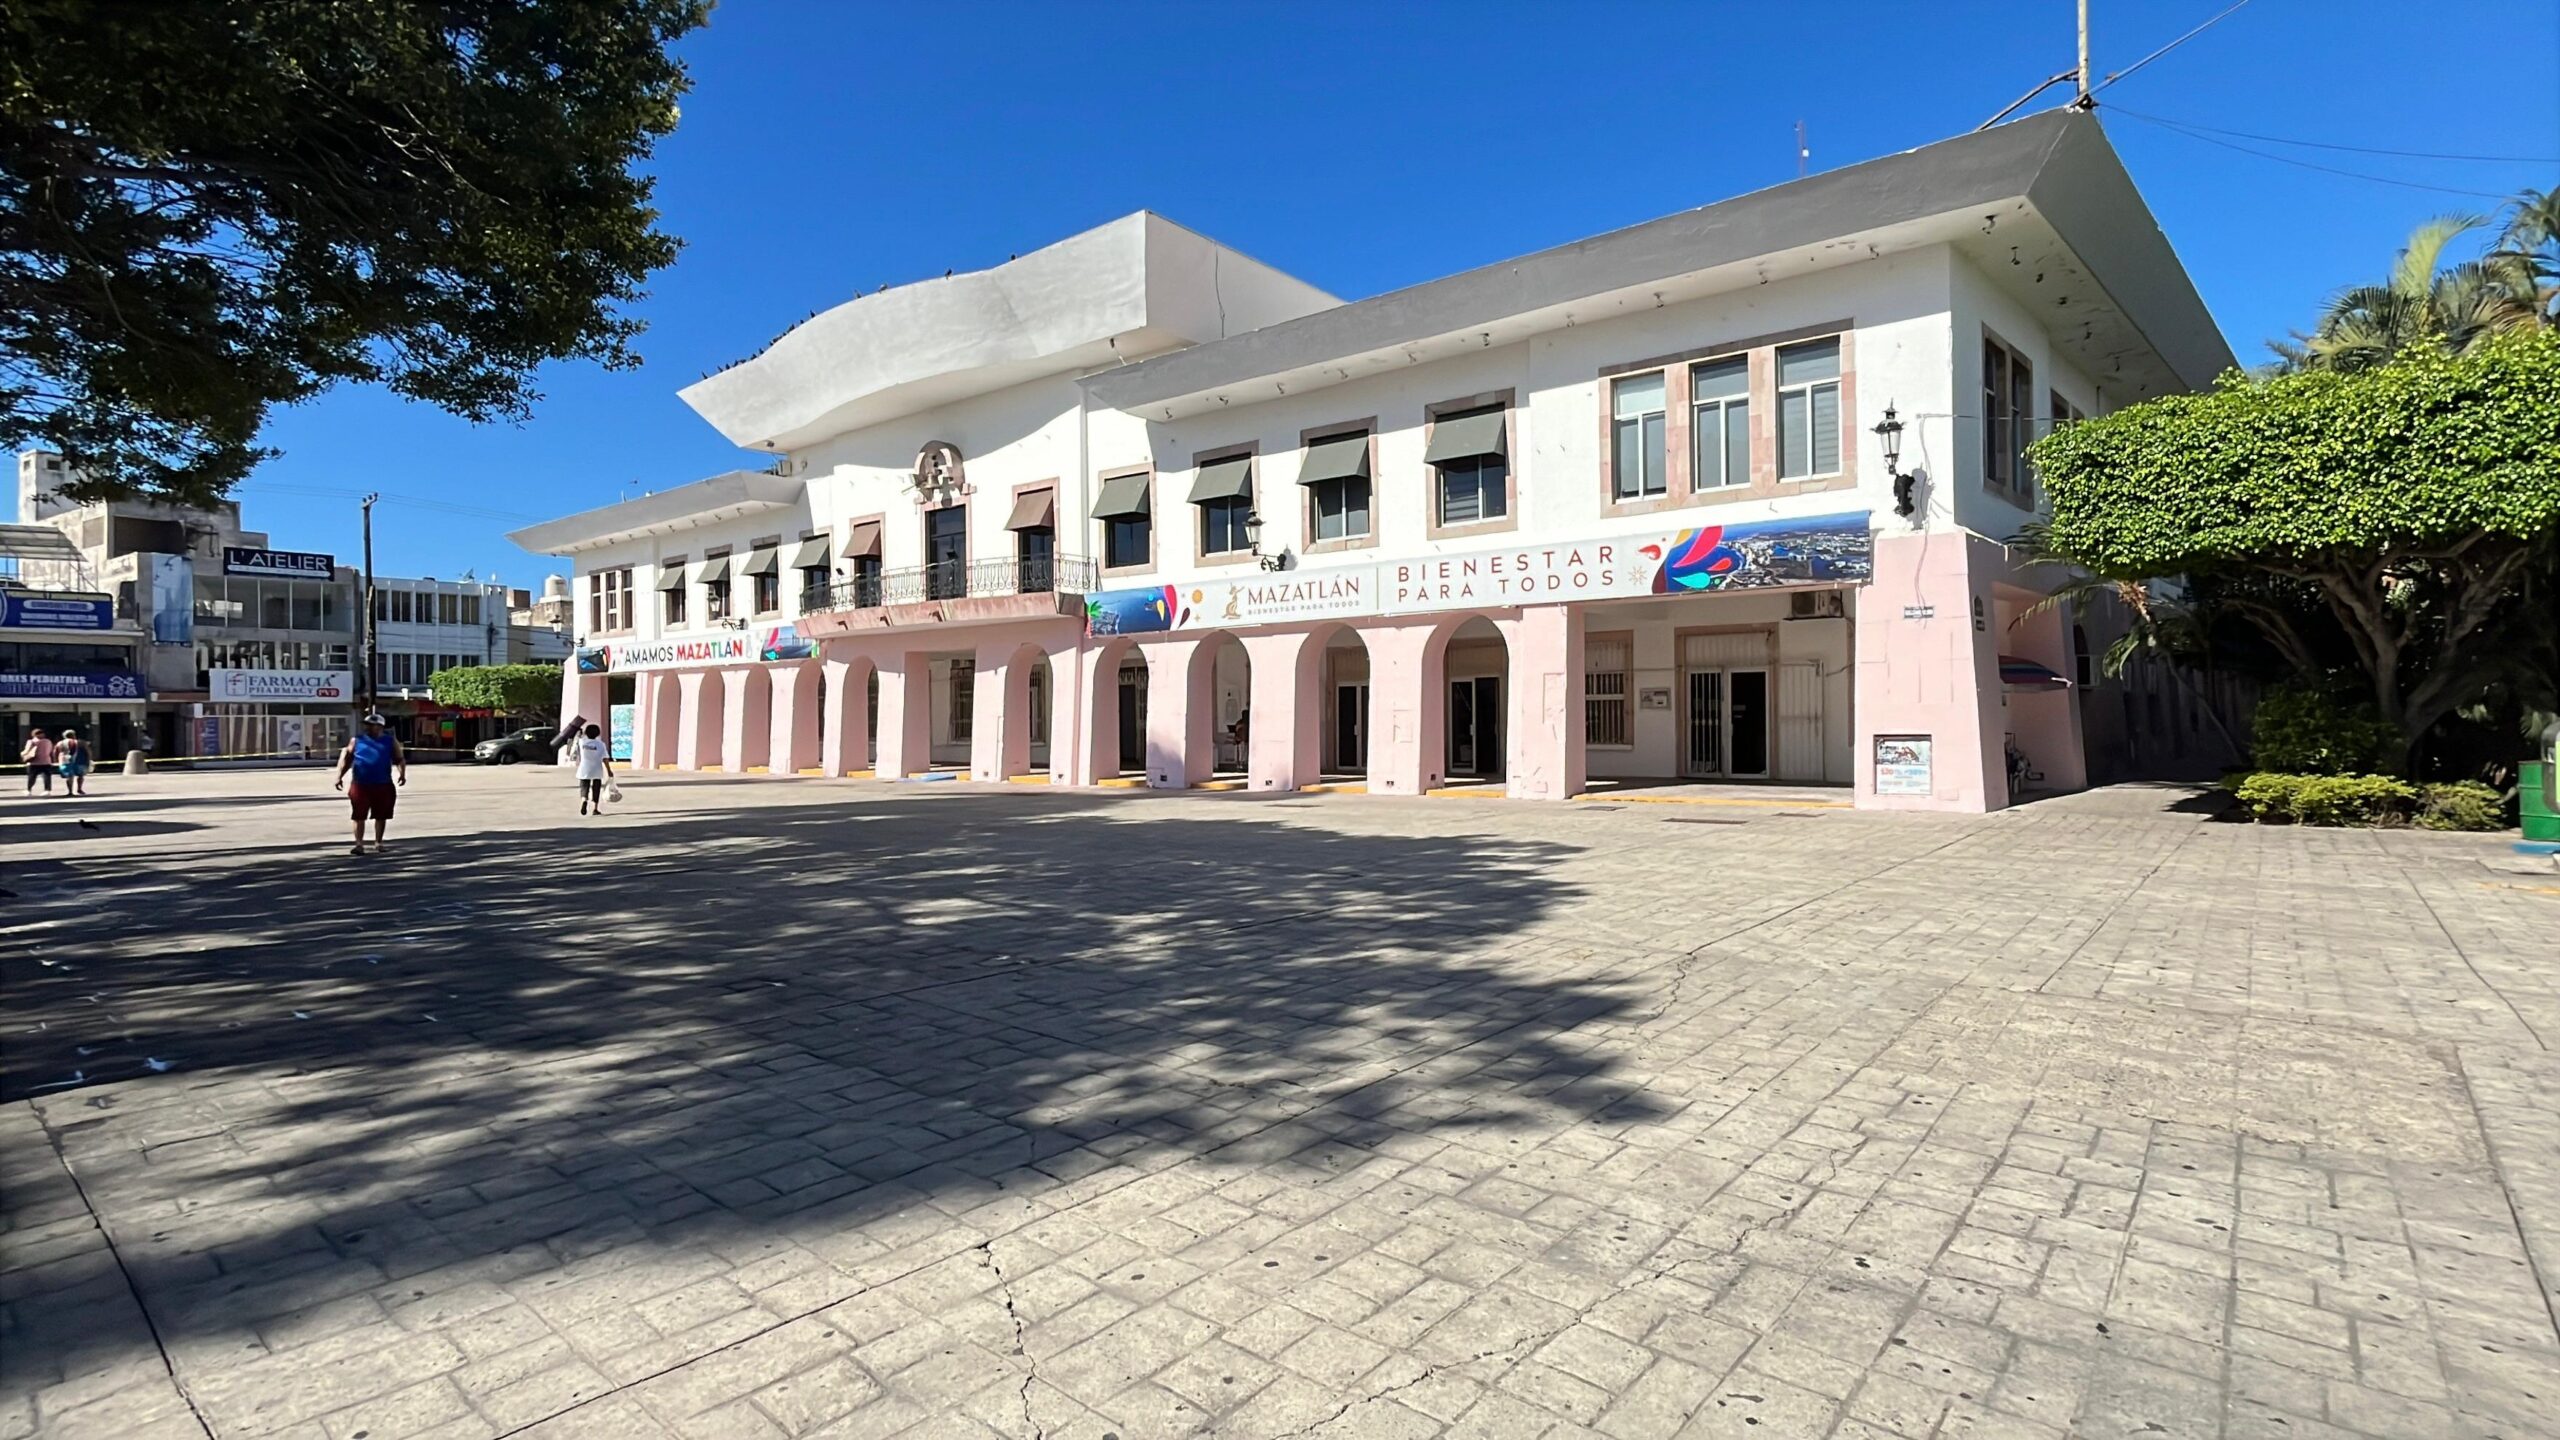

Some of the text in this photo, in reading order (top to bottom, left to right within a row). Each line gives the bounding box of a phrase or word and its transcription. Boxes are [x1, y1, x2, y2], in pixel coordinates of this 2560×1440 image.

[1398, 546, 1613, 582] BIENESTAR
[1248, 573, 1360, 605] MAZATLÁN
[1398, 570, 1614, 602] PARA TODOS
[1329, 600, 1360, 609] TODOS
[624, 636, 743, 665] AMAMOS MAZATLÁN
[29, 674, 87, 685] PEDIATRAS
[248, 675, 332, 687] FARMACIA
